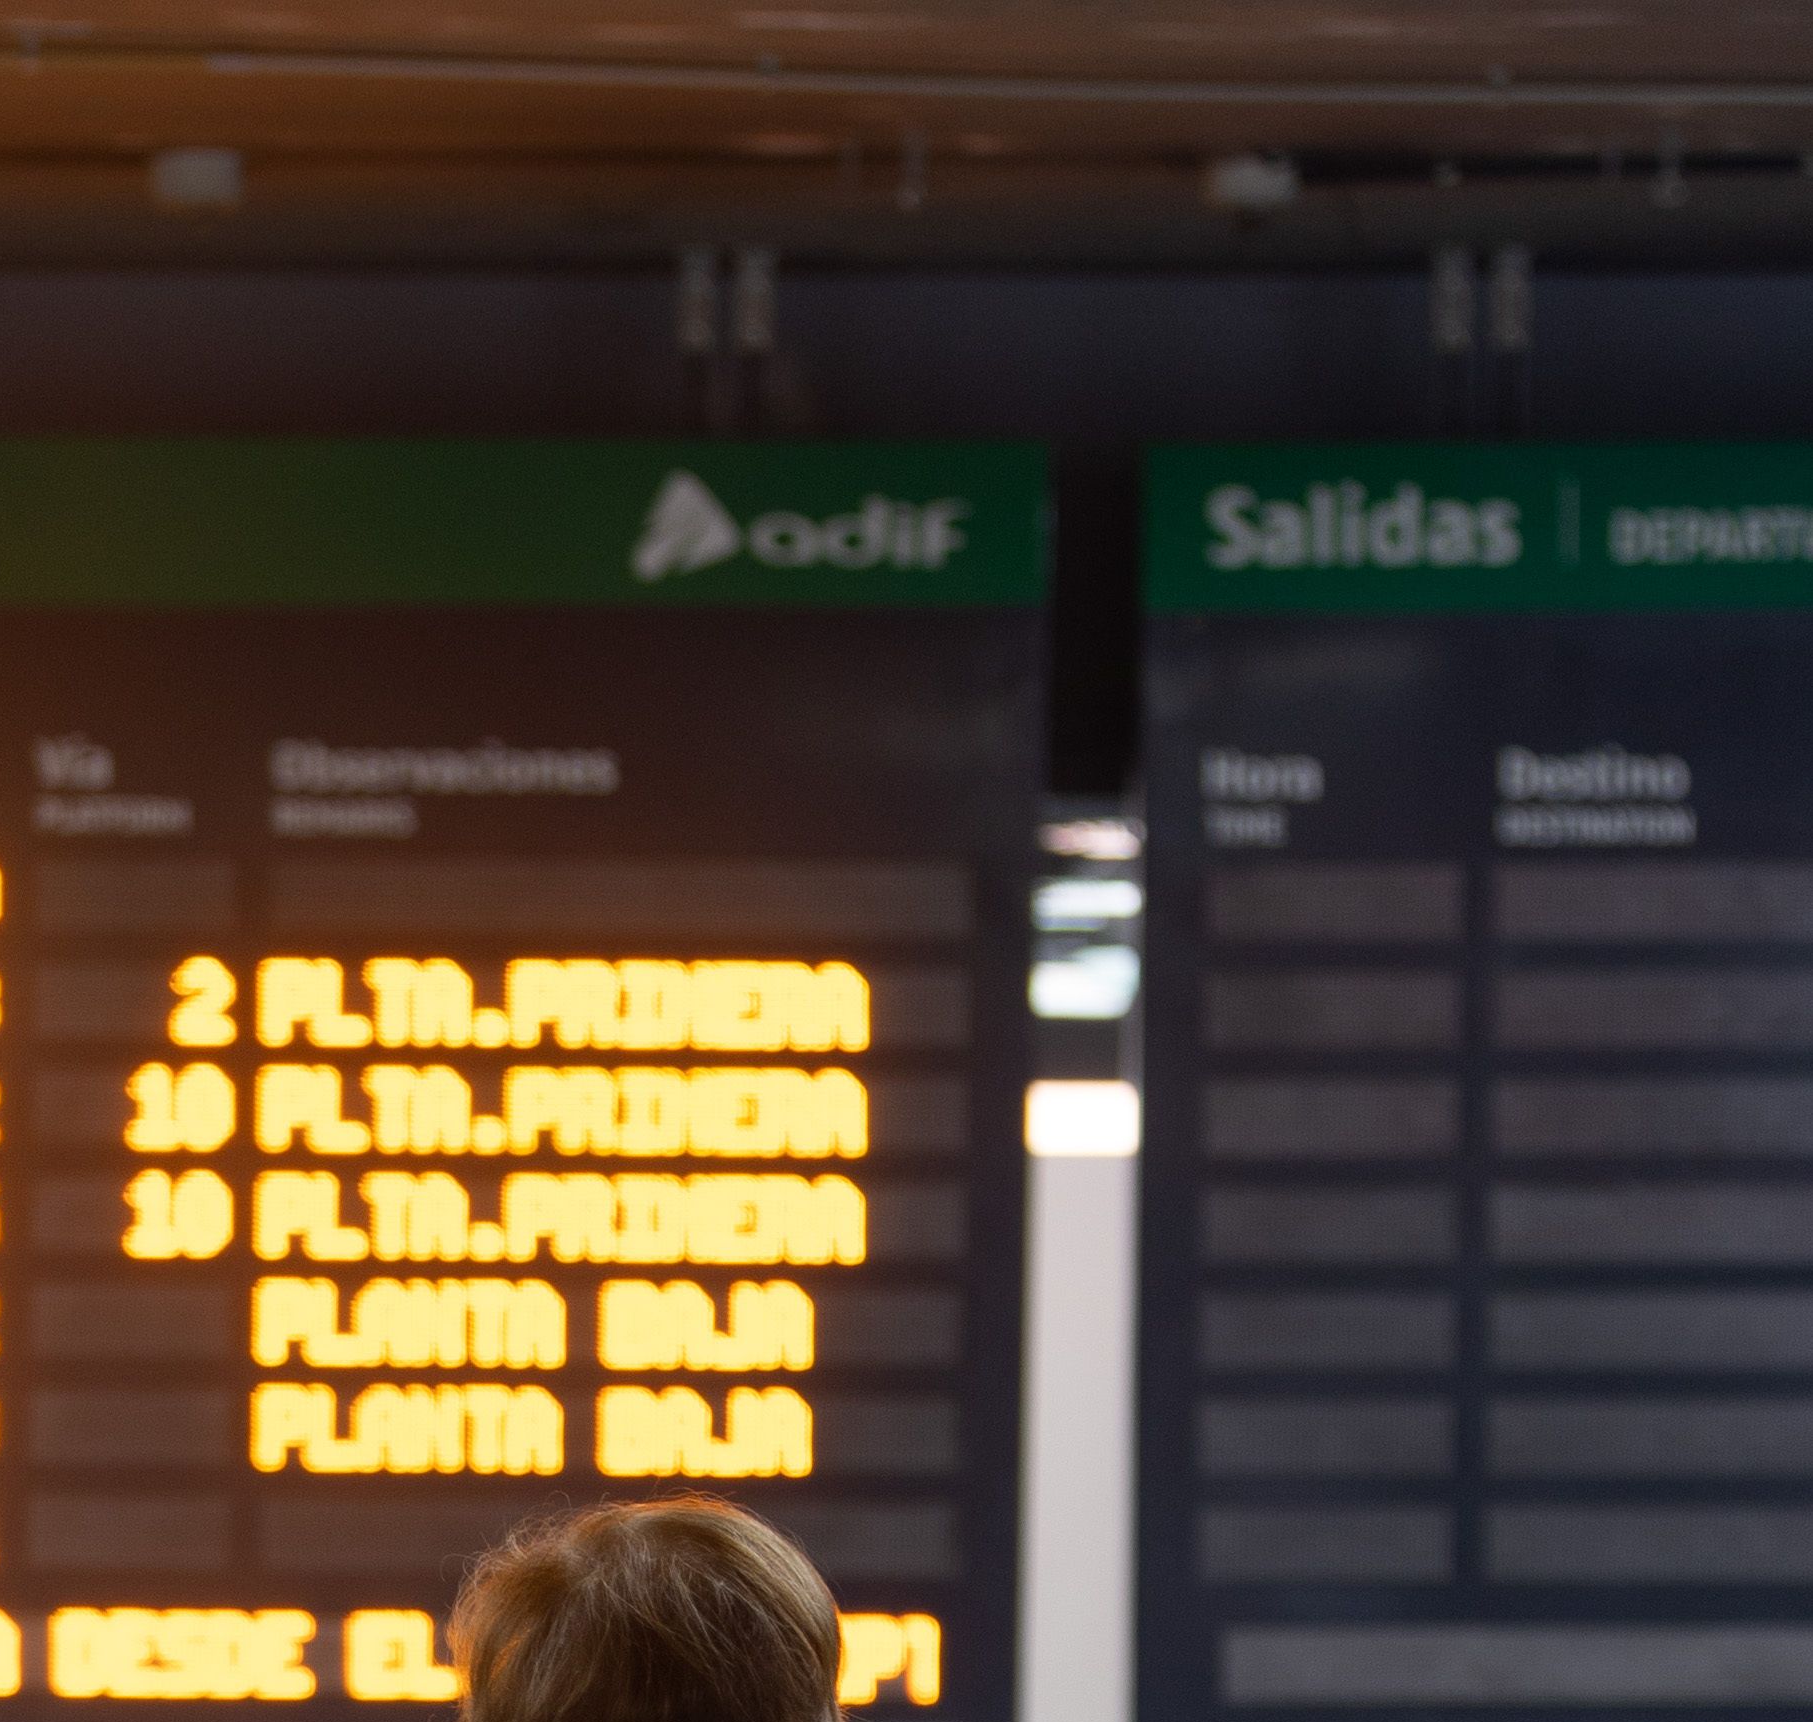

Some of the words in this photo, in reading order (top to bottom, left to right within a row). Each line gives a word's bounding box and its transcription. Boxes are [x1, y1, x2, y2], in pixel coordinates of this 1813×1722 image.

[749, 496, 969, 570] adif
[1207, 482, 1521, 570] Salidas
[169, 957, 236, 1046] 2
[125, 1063, 236, 1152] 10
[123, 1169, 233, 1259] 10
[252, 1277, 566, 1369] PLANTA
[598, 1280, 814, 1371] BAJA
[251, 1383, 563, 1475] PLANTA
[596, 1386, 812, 1477] BAJA
[49, 1608, 316, 1700] DESDE
